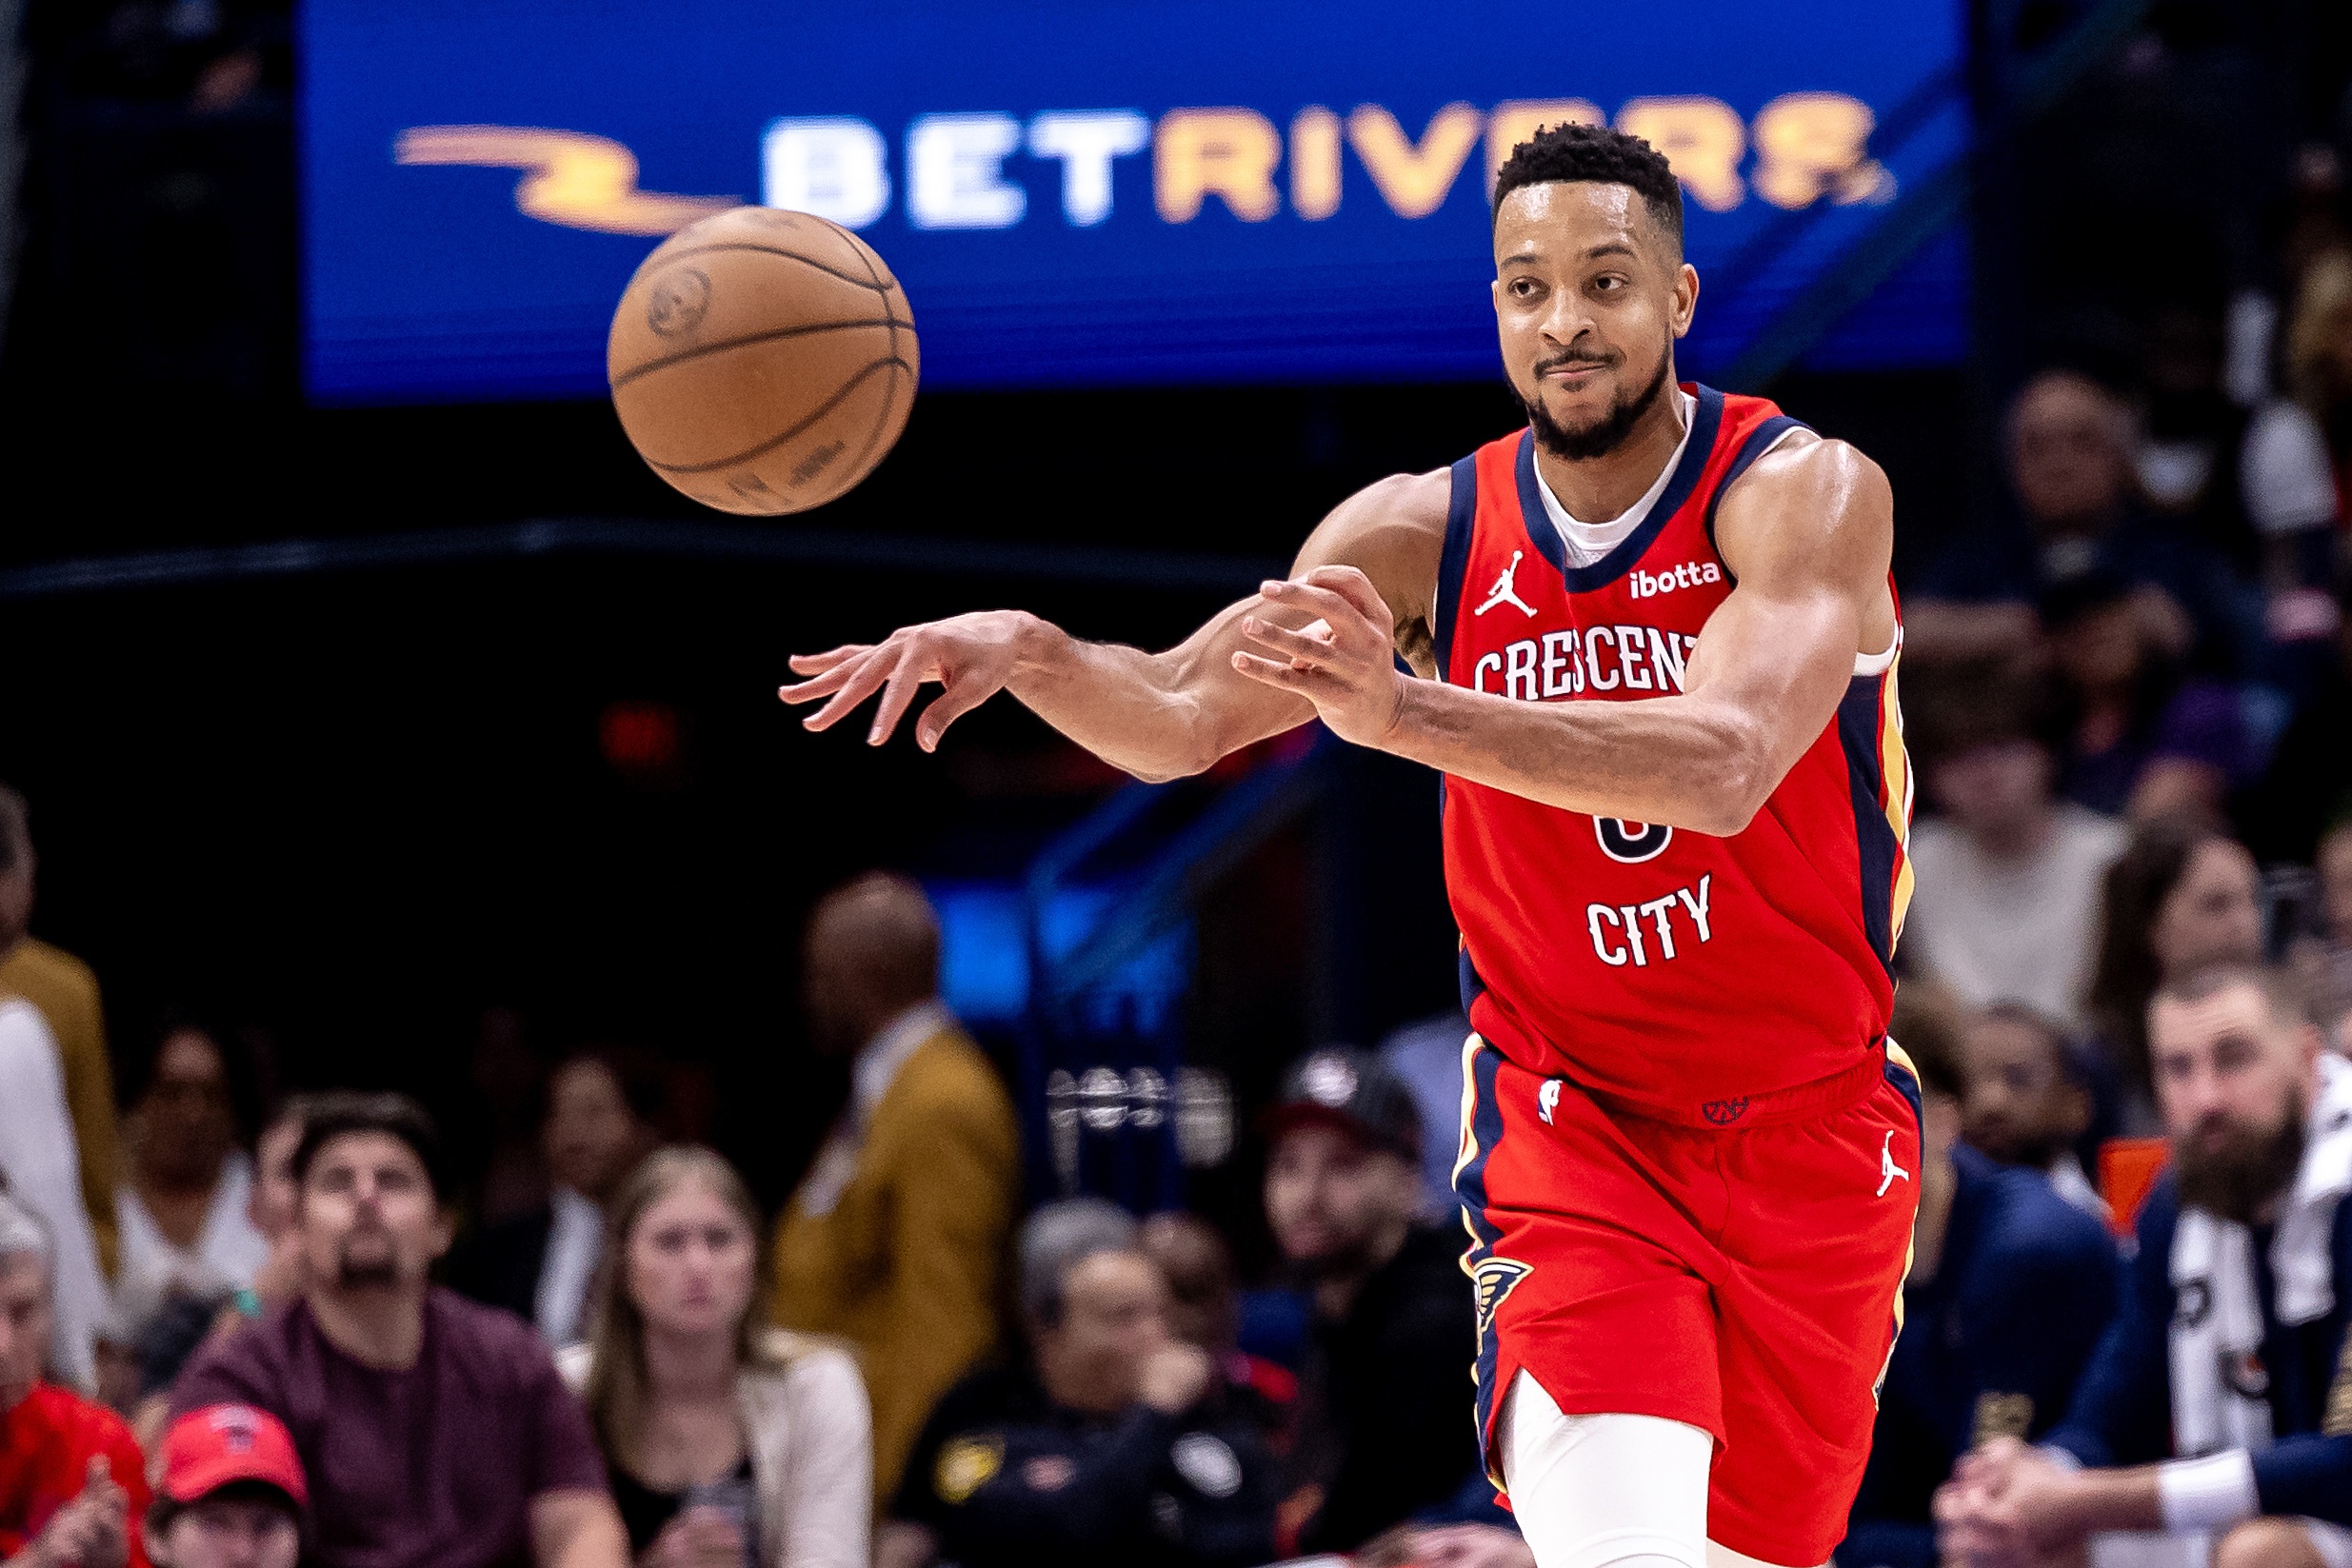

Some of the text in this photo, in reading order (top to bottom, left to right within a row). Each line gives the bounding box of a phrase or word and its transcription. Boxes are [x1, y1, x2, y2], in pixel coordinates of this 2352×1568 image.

[1629, 561, 1721, 599] ibotta
[1474, 625, 1699, 701] CRESCEN
[1586, 873, 1711, 967] CITY
